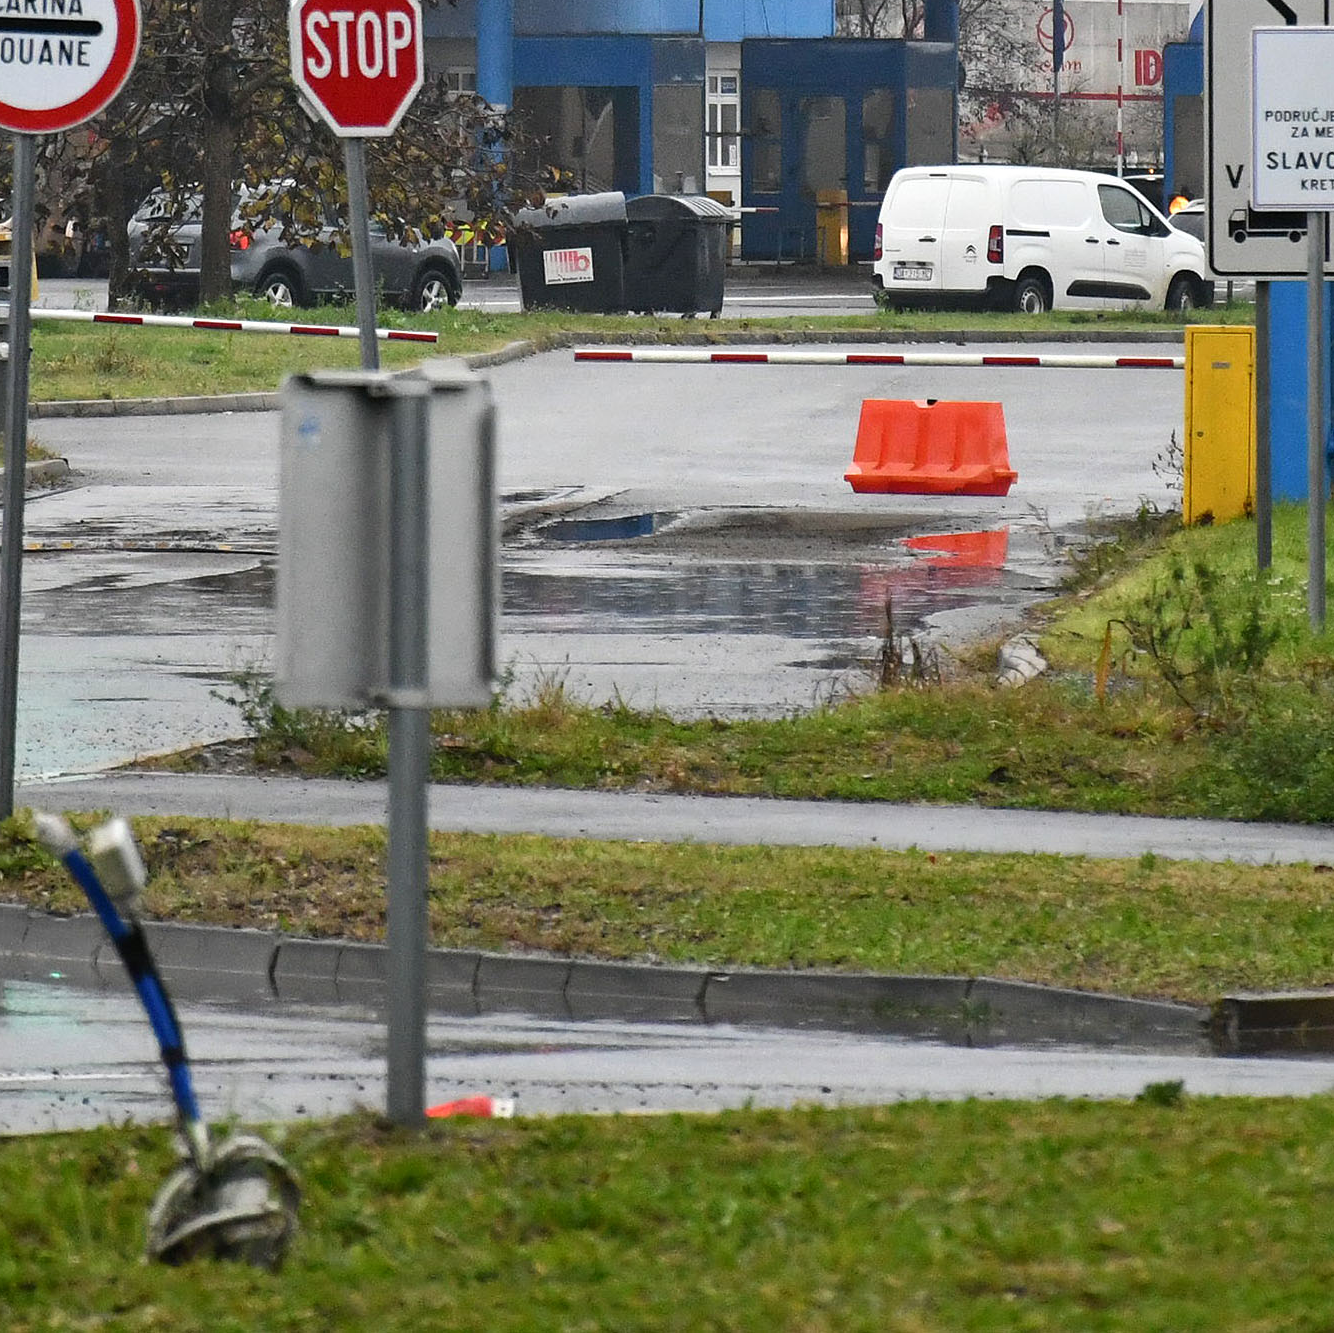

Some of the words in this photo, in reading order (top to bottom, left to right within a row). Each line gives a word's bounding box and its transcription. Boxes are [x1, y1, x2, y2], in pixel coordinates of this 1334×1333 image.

[305, 10, 413, 79] STOP
[1290, 126, 1309, 138] ZA
[1225, 164, 1246, 189] V
